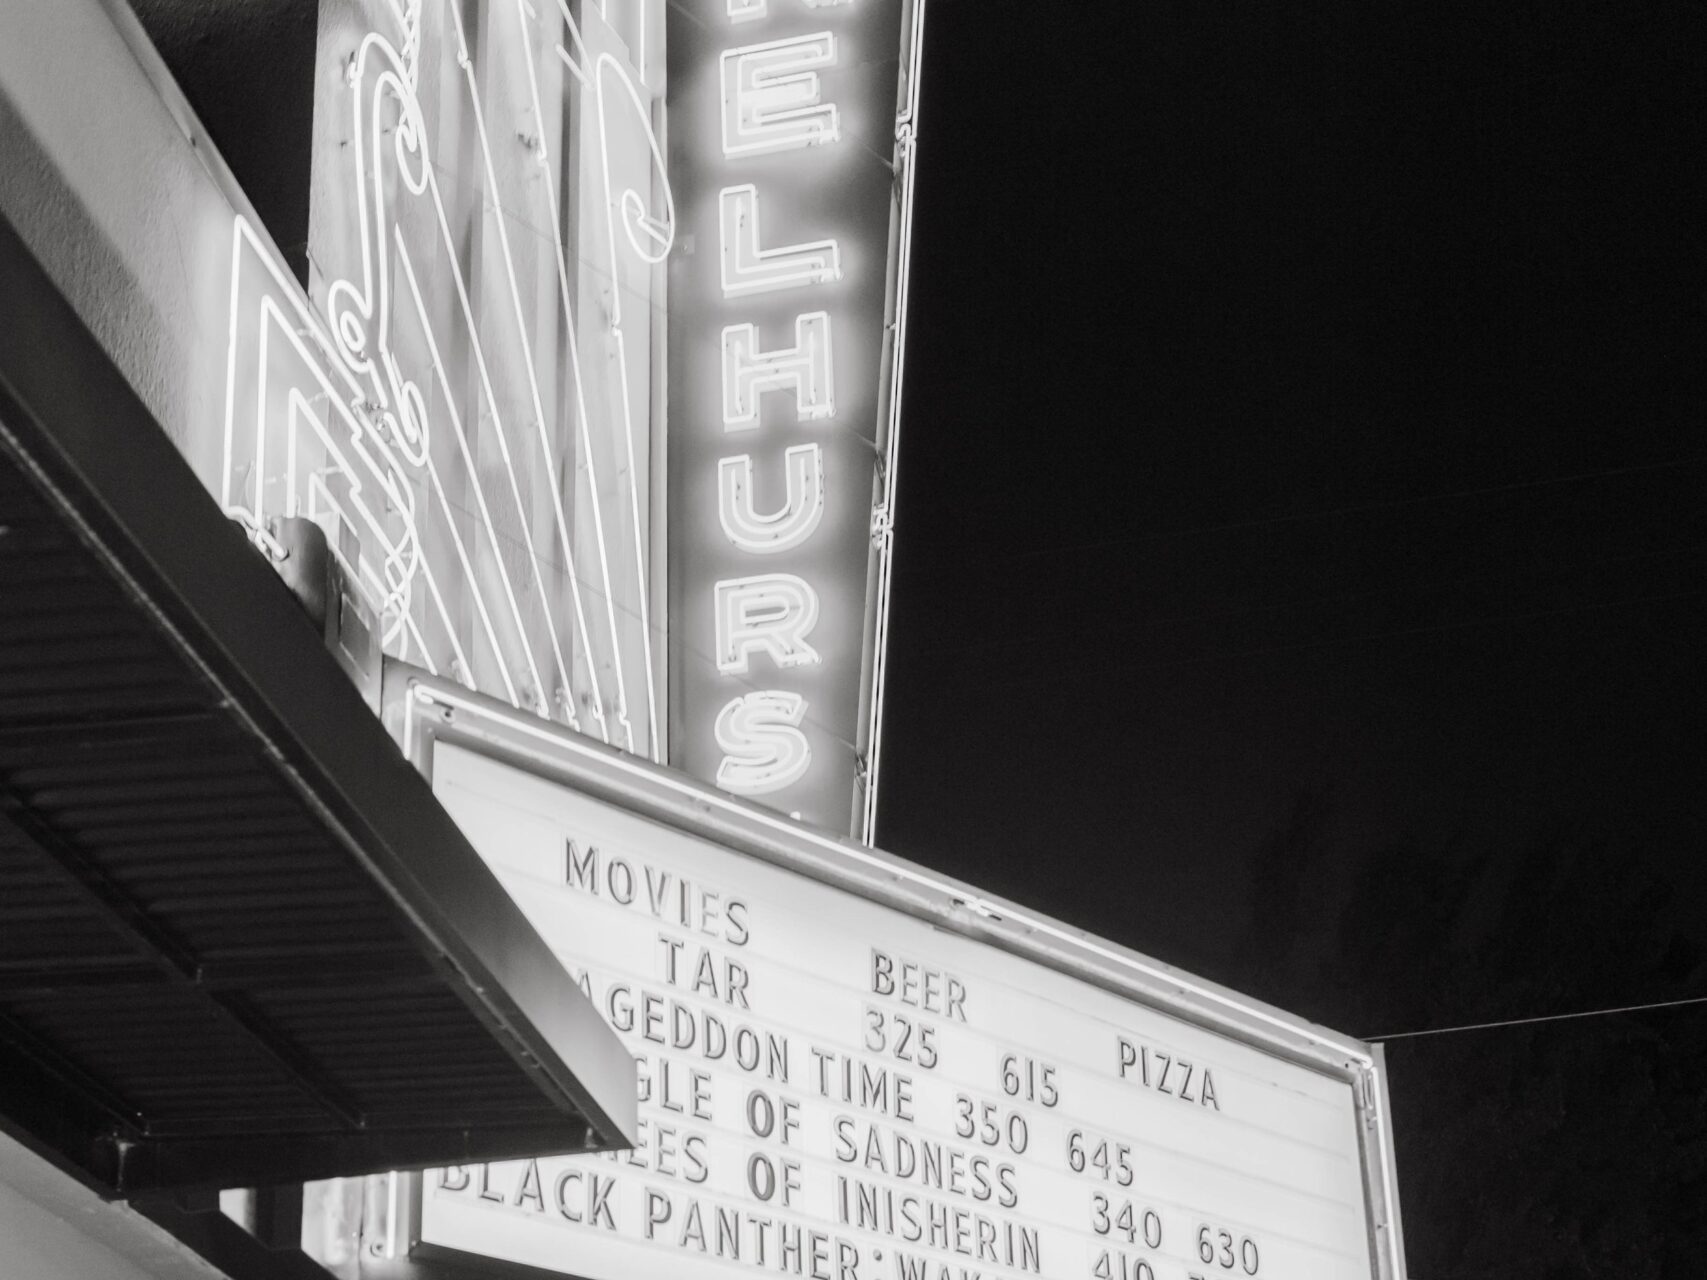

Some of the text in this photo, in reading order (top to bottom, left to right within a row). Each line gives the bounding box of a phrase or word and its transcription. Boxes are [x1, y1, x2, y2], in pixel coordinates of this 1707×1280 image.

[714, 0, 850, 796] ELHURS
[565, 838, 1221, 1111] MOVIES BEER PIZZA
[658, 934, 1060, 1107] TAR 325 615
[608, 1120, 710, 1184] EES
[747, 1152, 801, 1206] OF
[837, 1176, 1041, 1274] INISHERIN
[747, 1088, 801, 1144] OF
[833, 1115, 1018, 1209] SADNESS
[1091, 1192, 1162, 1250] 340
[1198, 1223, 1259, 1276] 630
[811, 1048, 914, 1121] TIME
[954, 1095, 1029, 1155] 350
[1066, 1130, 1134, 1187] 645
